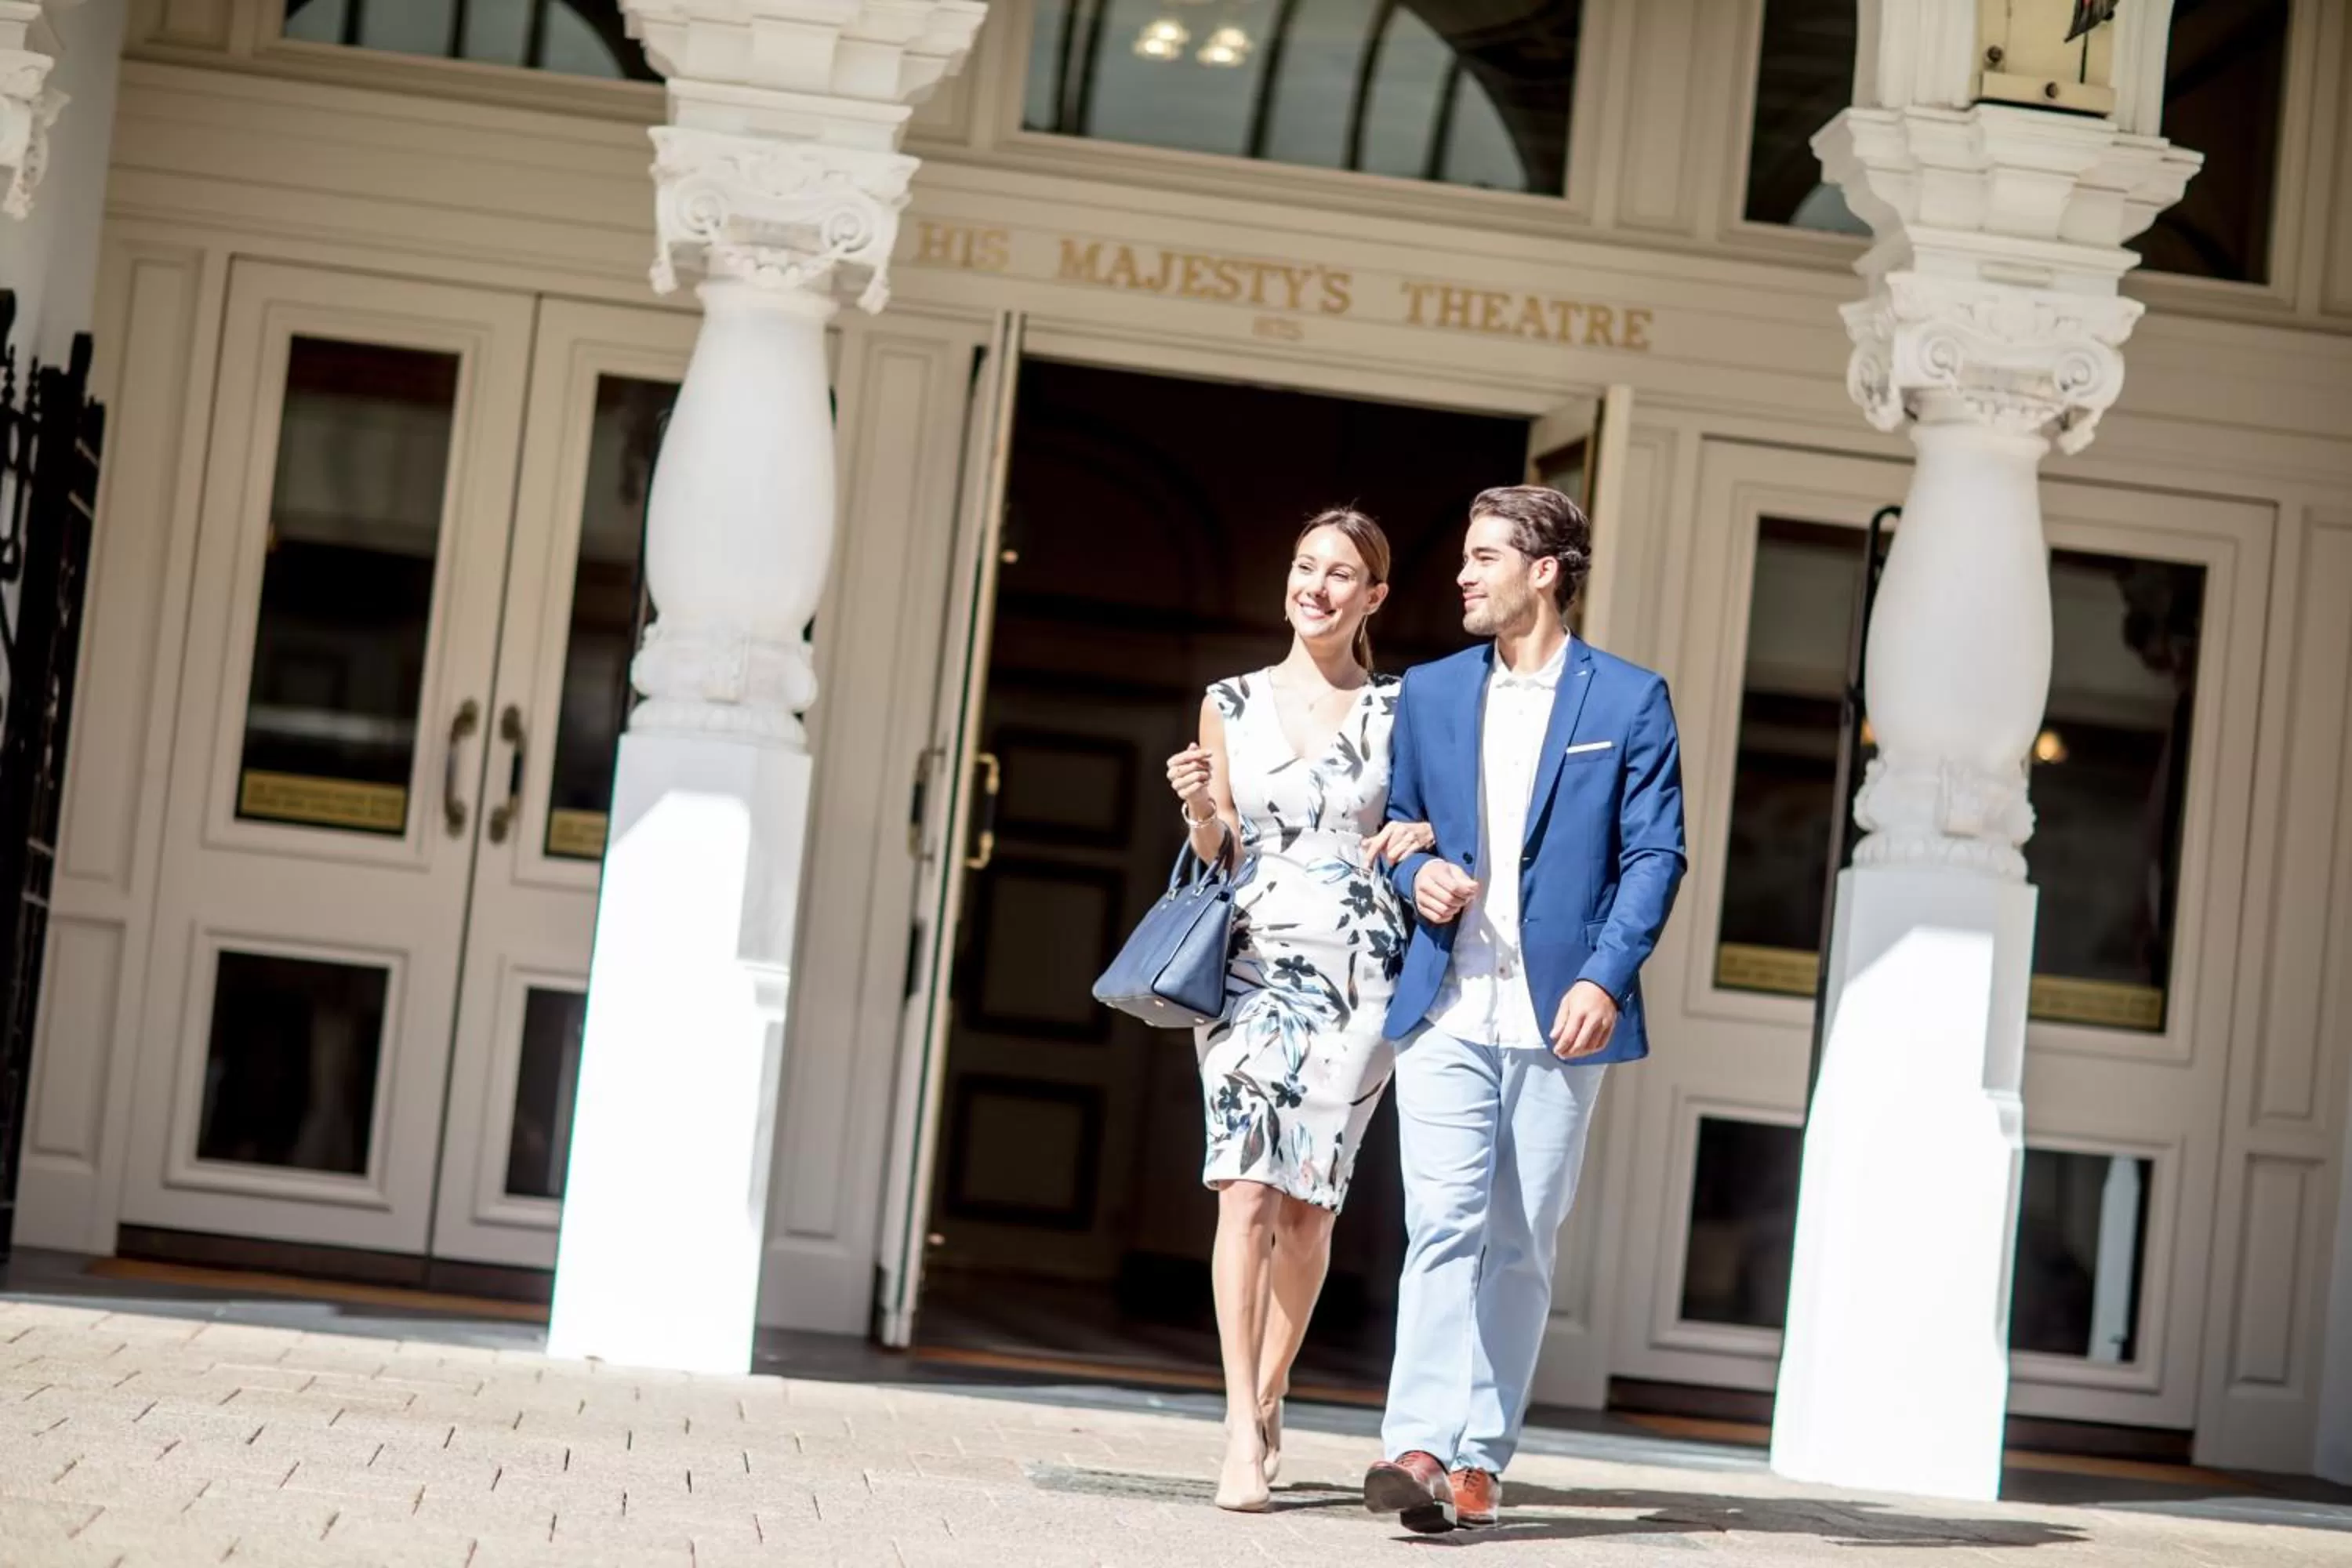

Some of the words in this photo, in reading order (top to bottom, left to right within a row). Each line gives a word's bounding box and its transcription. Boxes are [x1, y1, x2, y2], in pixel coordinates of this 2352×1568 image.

[916, 220, 1010, 271] HIS
[1057, 238, 1353, 315] MAJESTY'S
[1399, 280, 1653, 350] THEATRE
